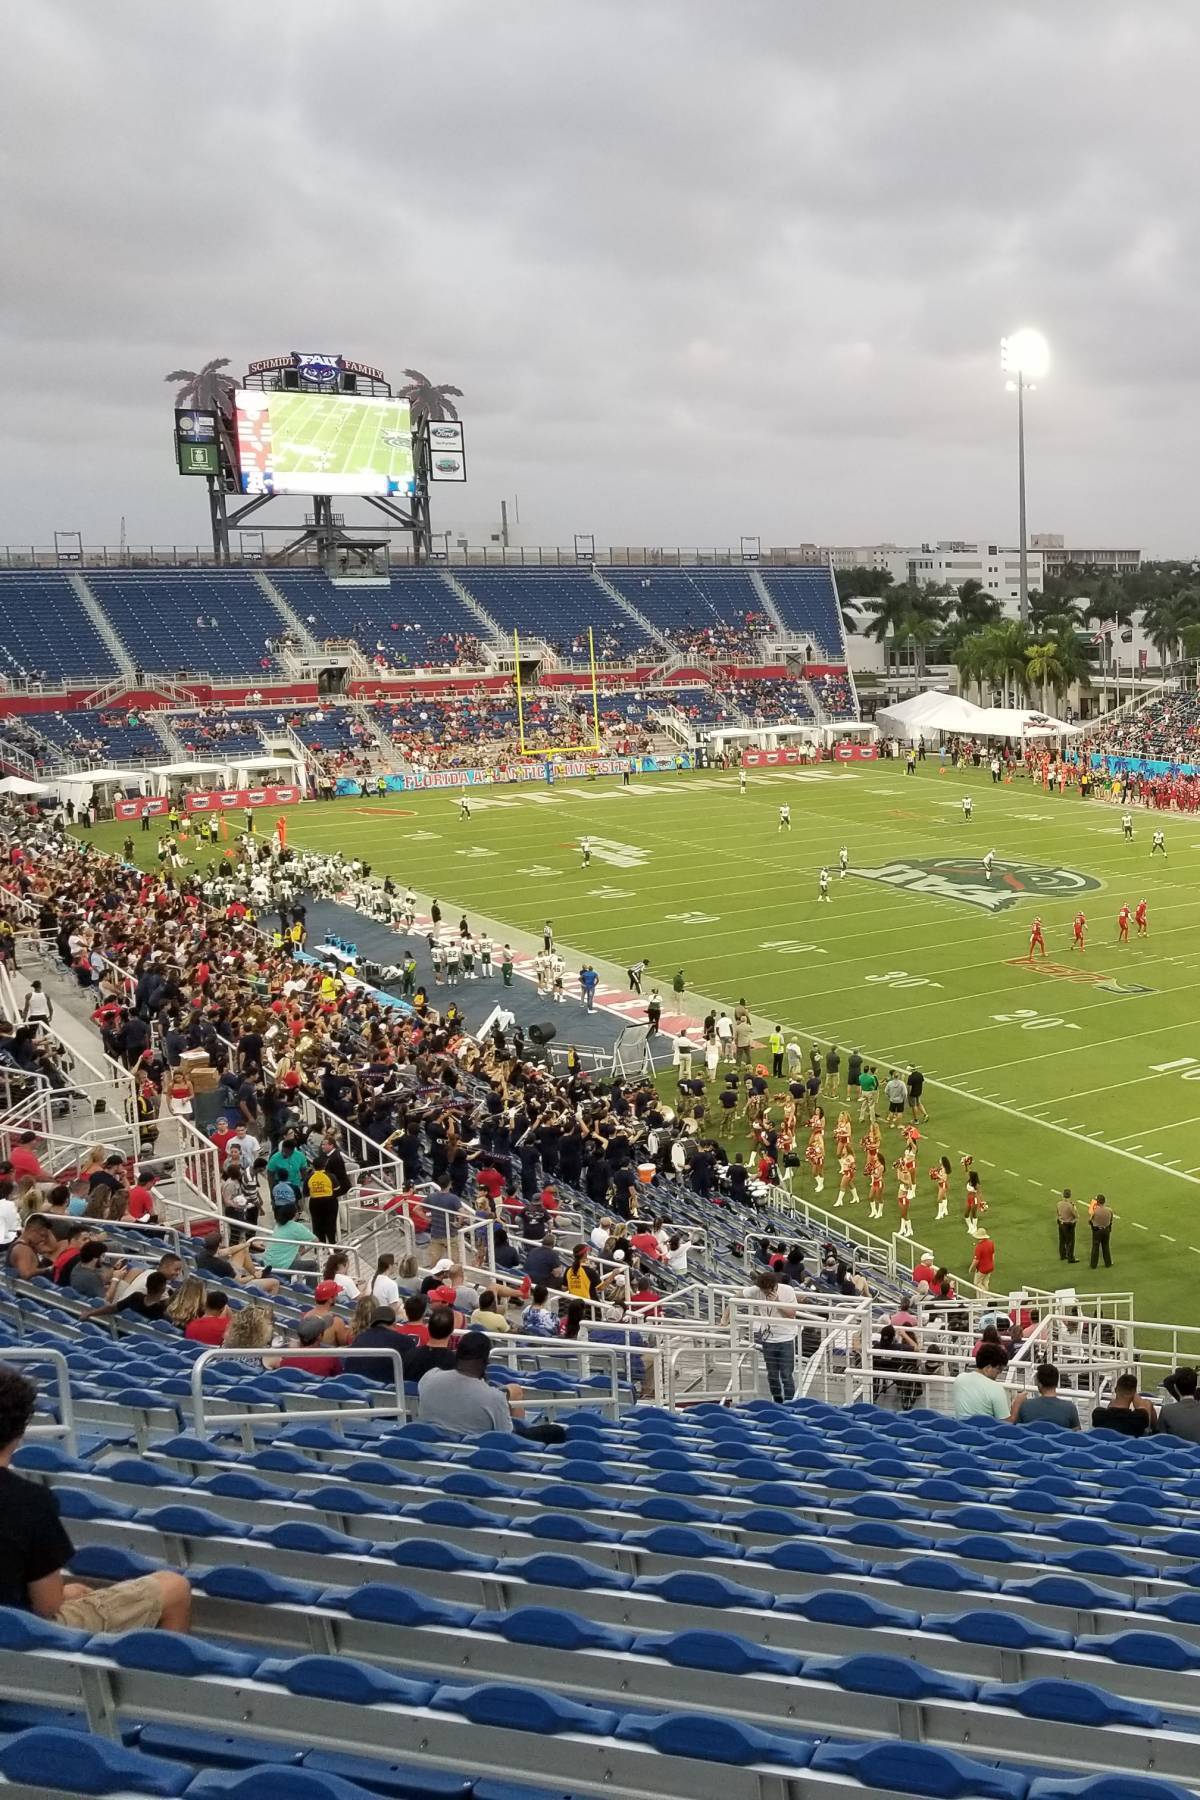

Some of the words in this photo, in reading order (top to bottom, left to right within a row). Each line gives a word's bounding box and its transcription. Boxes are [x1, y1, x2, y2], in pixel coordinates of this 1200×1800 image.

[251, 357, 294, 373] SCHMIDT
[345, 361, 384, 379] FAMILY
[405, 771, 469, 788] FLORIDA
[865, 971, 931, 988] 30
[989, 1009, 1065, 1030] 20
